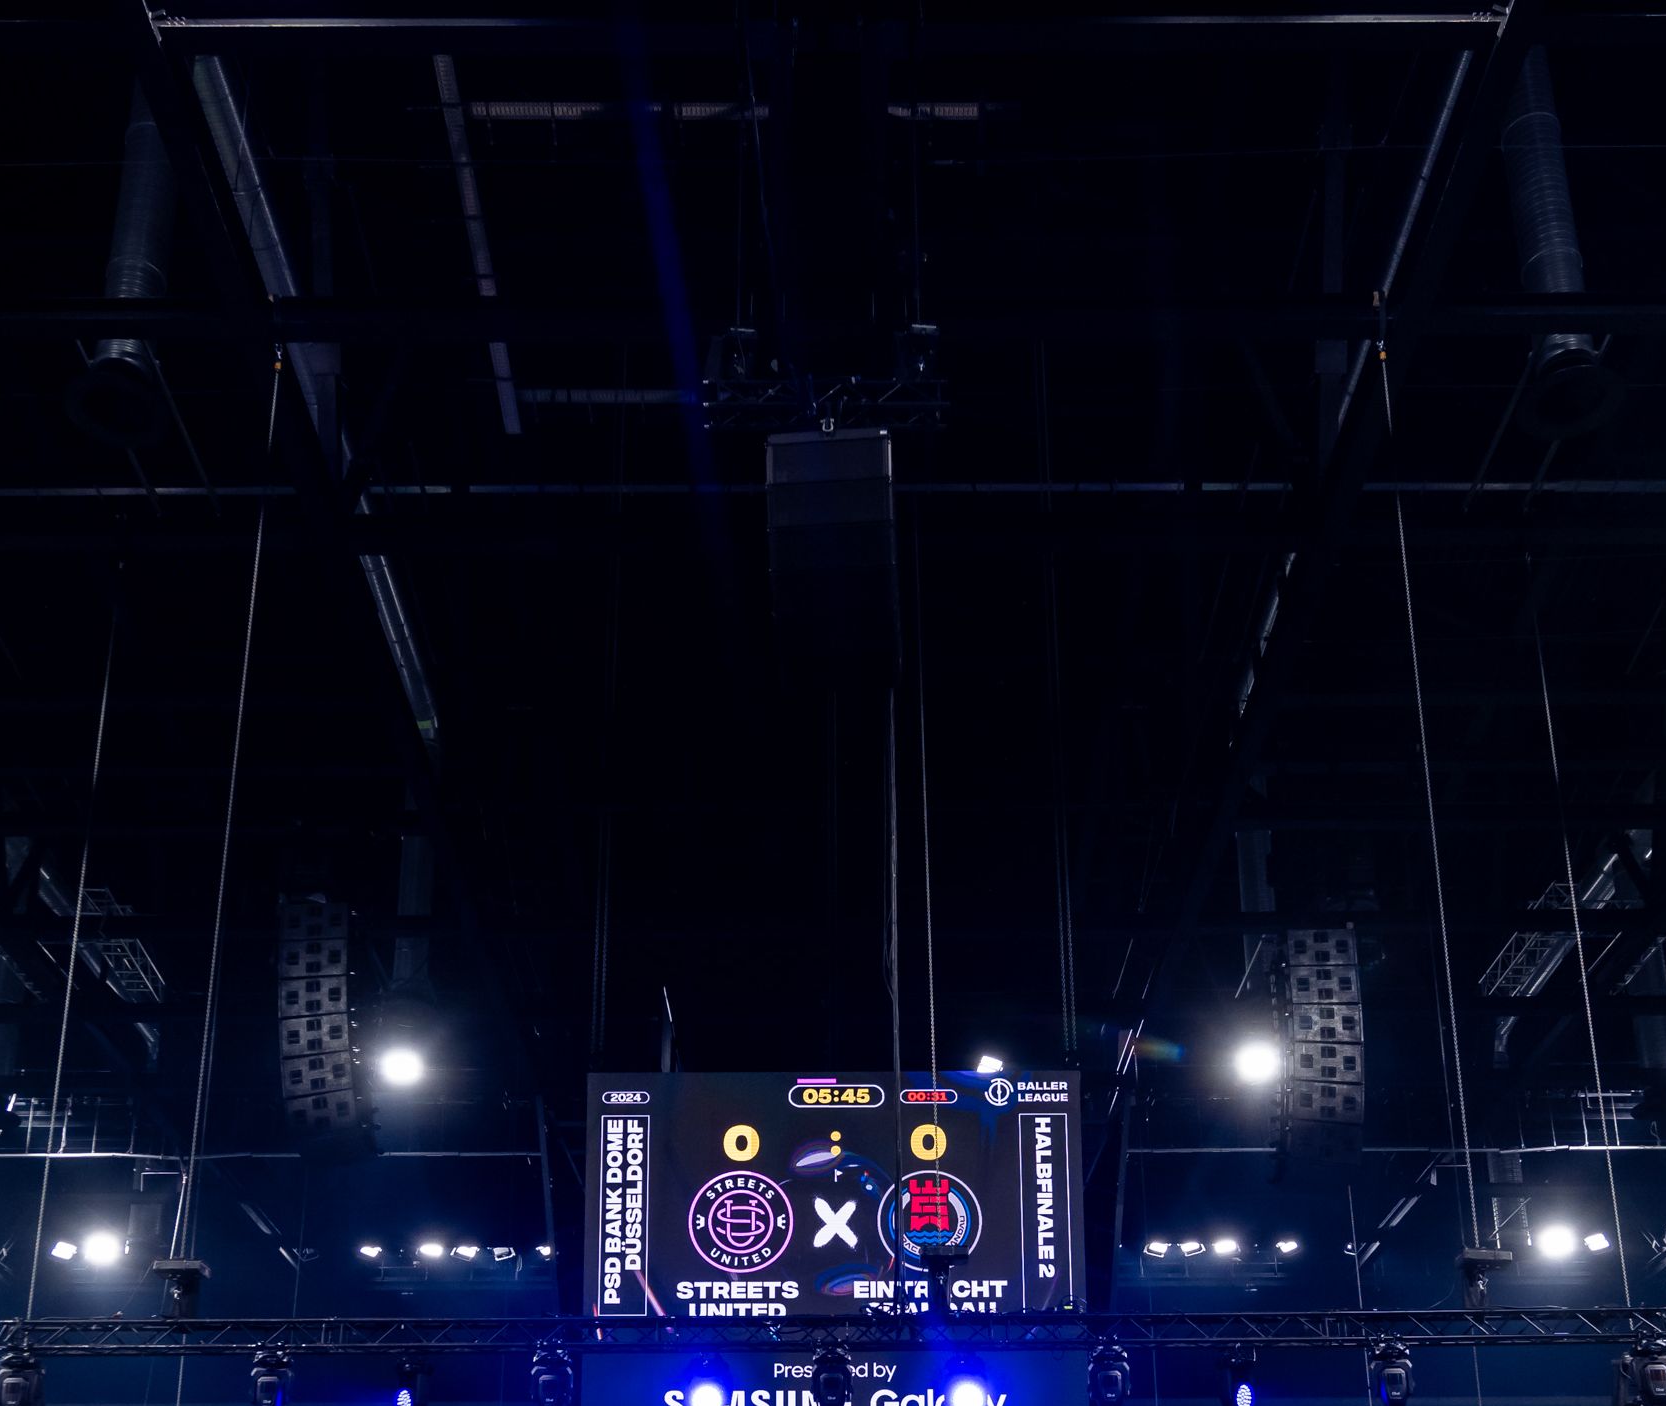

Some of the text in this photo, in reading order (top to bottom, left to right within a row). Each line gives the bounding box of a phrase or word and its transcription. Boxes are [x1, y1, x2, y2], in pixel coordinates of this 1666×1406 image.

[802, 1088, 871, 1104] 05:45
[1017, 1081, 1068, 1091] BALLER
[610, 1093, 641, 1102] 2024
[1017, 1092, 1069, 1102] LEAGUE
[723, 1124, 760, 1162] 0
[910, 1123, 947, 1161] 0
[622, 1119, 644, 1271] DÜSSELDORF
[706, 1177, 775, 1200] STREETS
[1034, 1117, 1056, 1278] HALBFINALE 2
[604, 1119, 624, 1304] PSD BANK DOME
[710, 1247, 773, 1267] UNITED
[676, 1280, 800, 1299] STREETS
[688, 1303, 787, 1316] UNITED
[773, 1362, 897, 1382] Presed by
